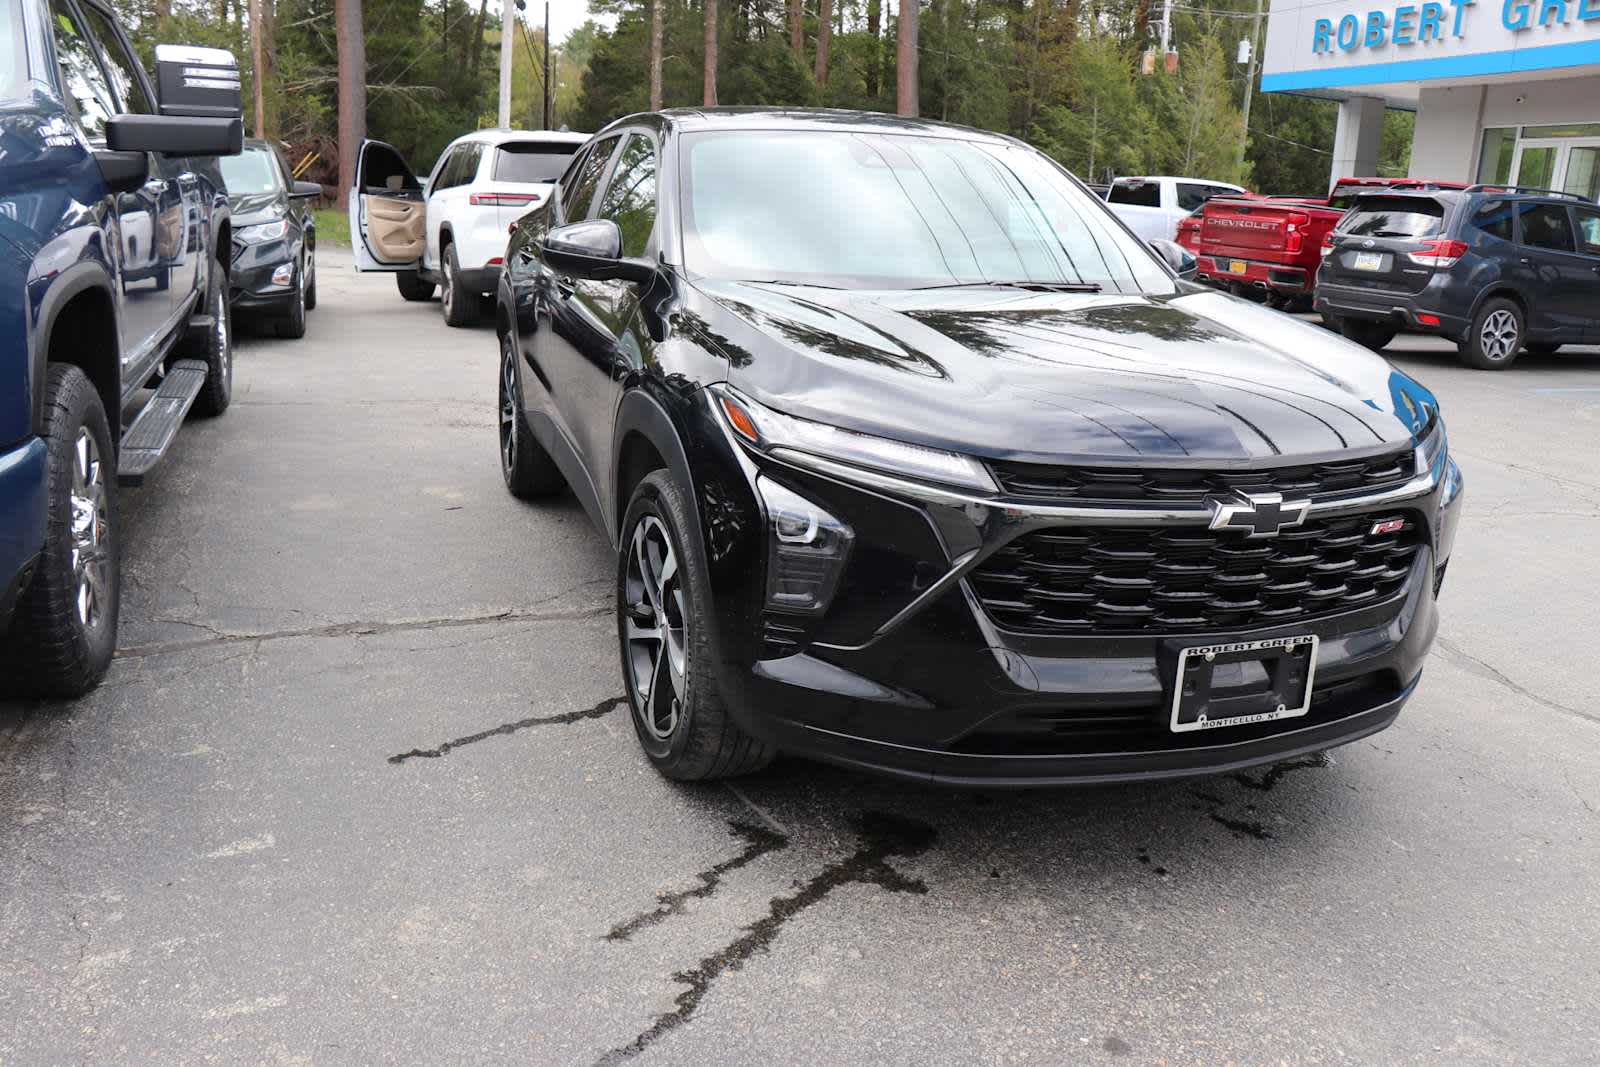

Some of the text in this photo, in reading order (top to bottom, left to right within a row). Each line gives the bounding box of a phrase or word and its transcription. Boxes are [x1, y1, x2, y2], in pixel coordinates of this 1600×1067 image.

[1312, 0, 1474, 53] ROBERT
[1207, 218, 1279, 230] CHEVROLET
[1187, 636, 1313, 656] ROBERT GREEN
